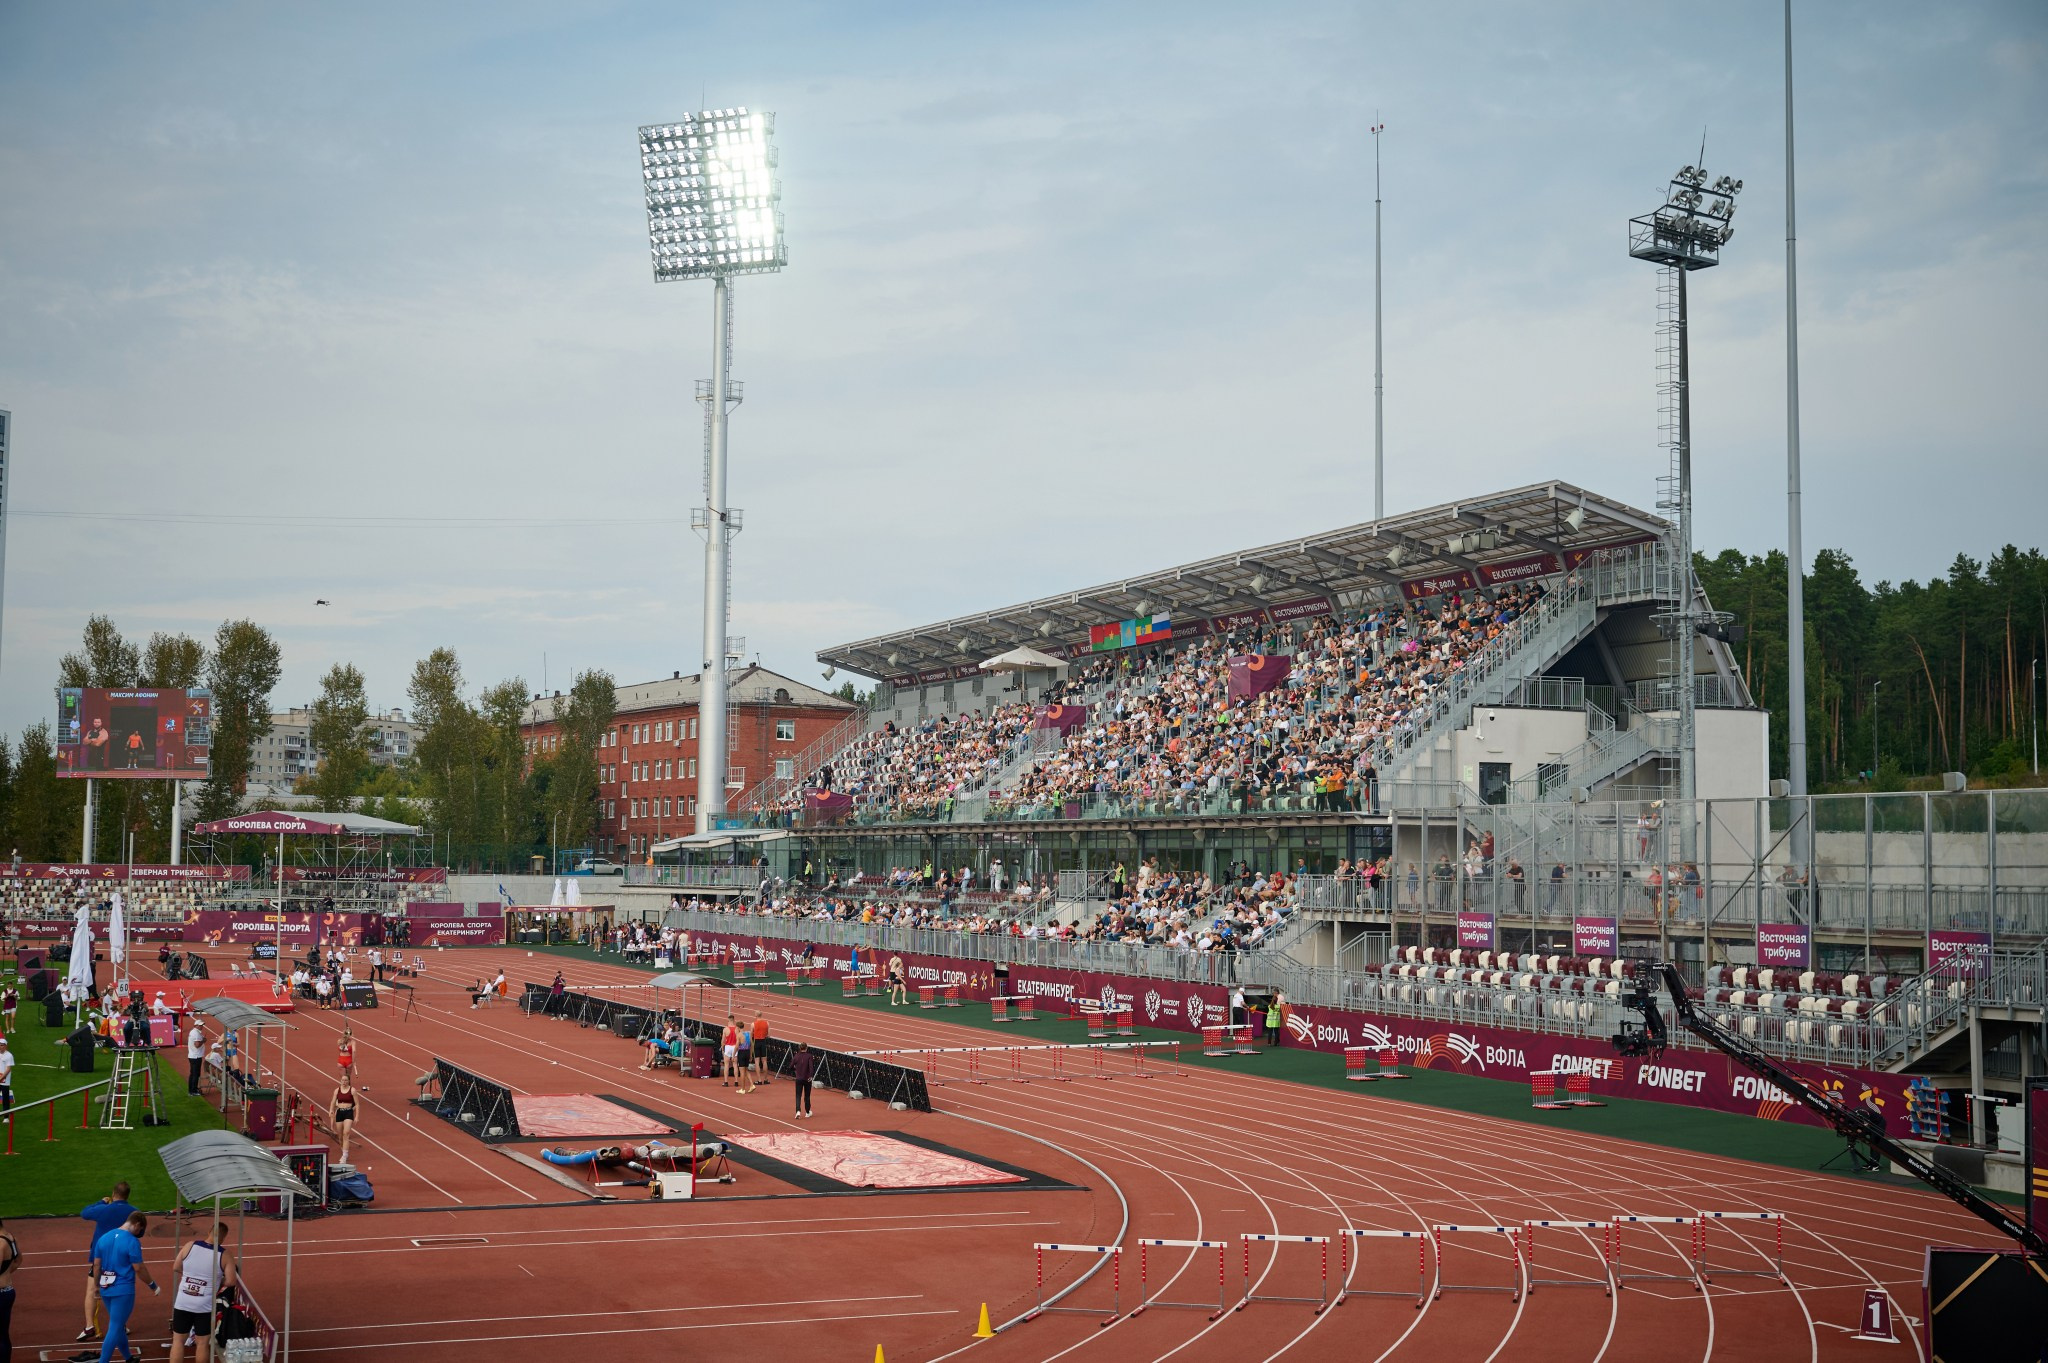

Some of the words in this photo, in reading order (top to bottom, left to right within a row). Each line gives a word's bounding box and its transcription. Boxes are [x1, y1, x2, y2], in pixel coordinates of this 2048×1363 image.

[1492, 562, 1542, 580] ЕКАТЕРИНБУРГ
[1439, 579, 1456, 590] ВФЛА
[1274, 605, 1304, 618] ВОСТОЧНАЯ
[1304, 601, 1329, 613] ТРИБУНА
[228, 820, 272, 830] КОРОЛЕВА
[274, 820, 307, 830] СПОРТА
[232, 922, 275, 931] КОРОЛЕВА
[279, 924, 311, 933] СПОРТА
[1459, 918, 1493, 931] Восточная
[1576, 922, 1615, 936] Восточная
[1461, 930, 1489, 943] трибуна
[1579, 935, 1610, 950] трибуна
[1759, 931, 1807, 945] Восточная
[1763, 944, 1801, 960] трибуна
[908, 965, 940, 982] КОРОЛЕВА
[942, 969, 967, 985] СПОРТА
[1017, 979, 1075, 1000] ЕКАТЕРИНБУРГ
[1317, 1025, 1350, 1045] ВФЛА
[1397, 1035, 1432, 1056] ВФЛА
[1486, 1046, 1526, 1069] ВФЛА
[1551, 1054, 1613, 1080] FONBET
[1638, 1064, 1706, 1093] FONBET
[1806, 1092, 1829, 1110] MovieTech
[1908, 1158, 1929, 1174] MovieTech
[2003, 1219, 2023, 1236] MovieTech
[187, 1283, 200, 1293] 183
[1868, 1301, 1881, 1329] 1
